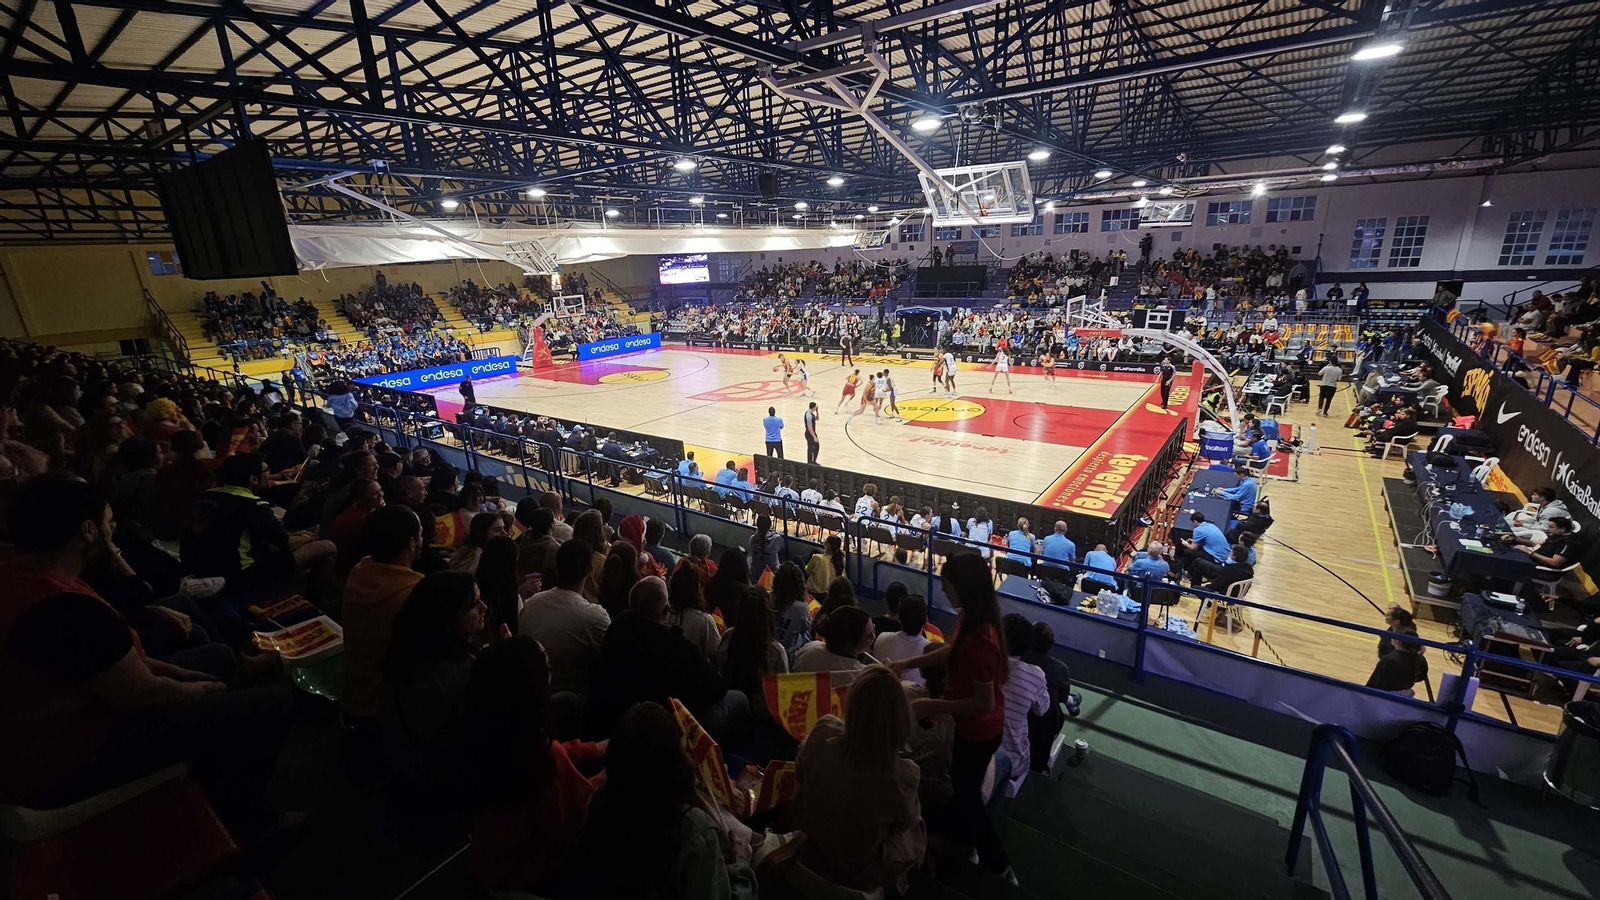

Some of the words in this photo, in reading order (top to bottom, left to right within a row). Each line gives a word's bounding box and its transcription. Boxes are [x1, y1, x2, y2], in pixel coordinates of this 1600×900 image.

[590, 342, 620, 354] endesa
[625, 337, 652, 348] endesa
[420, 367, 464, 383] endesa
[471, 359, 511, 374] endesa
[1517, 424, 1551, 468] endesa
[855, 505, 868, 516] 22
